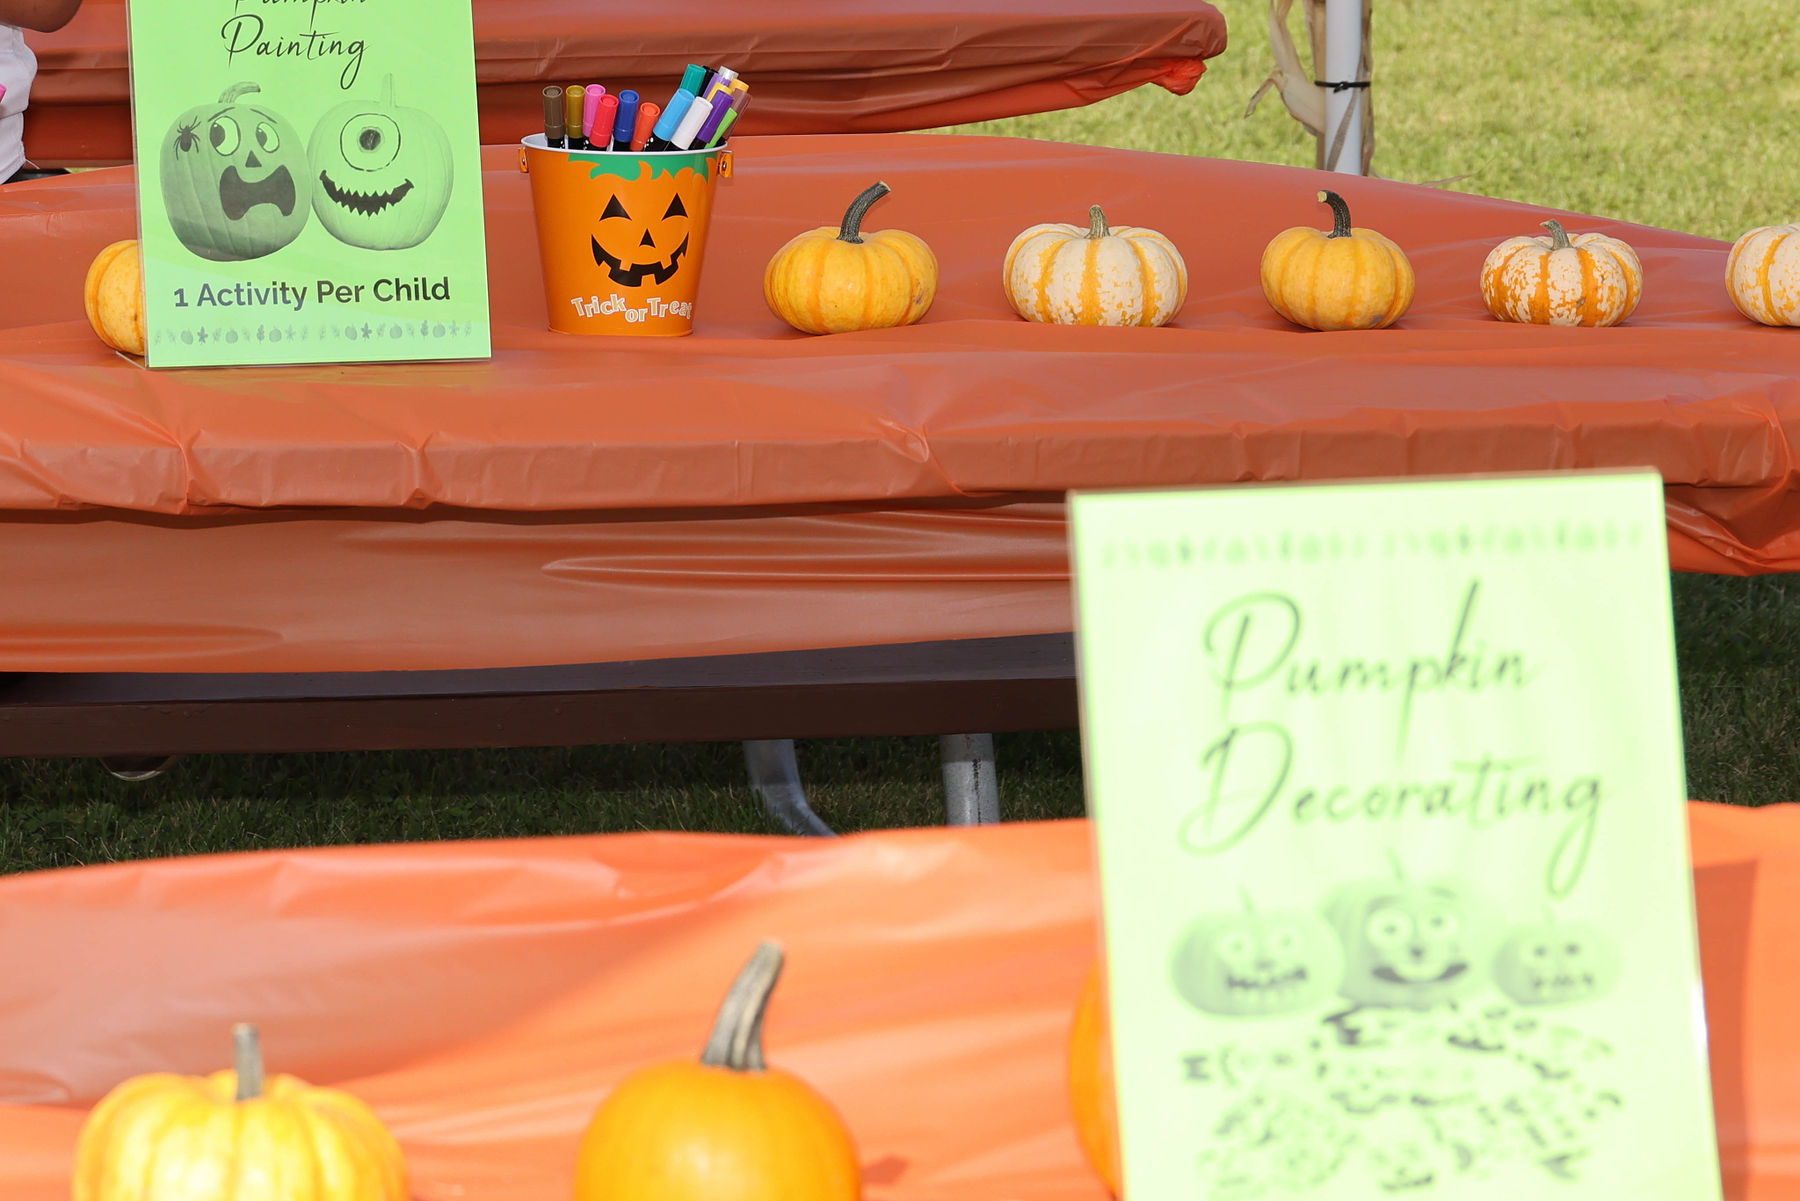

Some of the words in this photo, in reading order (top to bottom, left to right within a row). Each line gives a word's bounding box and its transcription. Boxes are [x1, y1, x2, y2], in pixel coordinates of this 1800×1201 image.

[221, 14, 369, 90] Painting
[173, 287, 189, 308] 1
[197, 281, 308, 311] Activity
[316, 279, 365, 304] Per
[373, 276, 451, 302] Child
[571, 294, 627, 318] Trick
[625, 307, 648, 323] or
[1203, 576, 1542, 762] Pumpkin
[1177, 720, 1604, 898] Decorating
